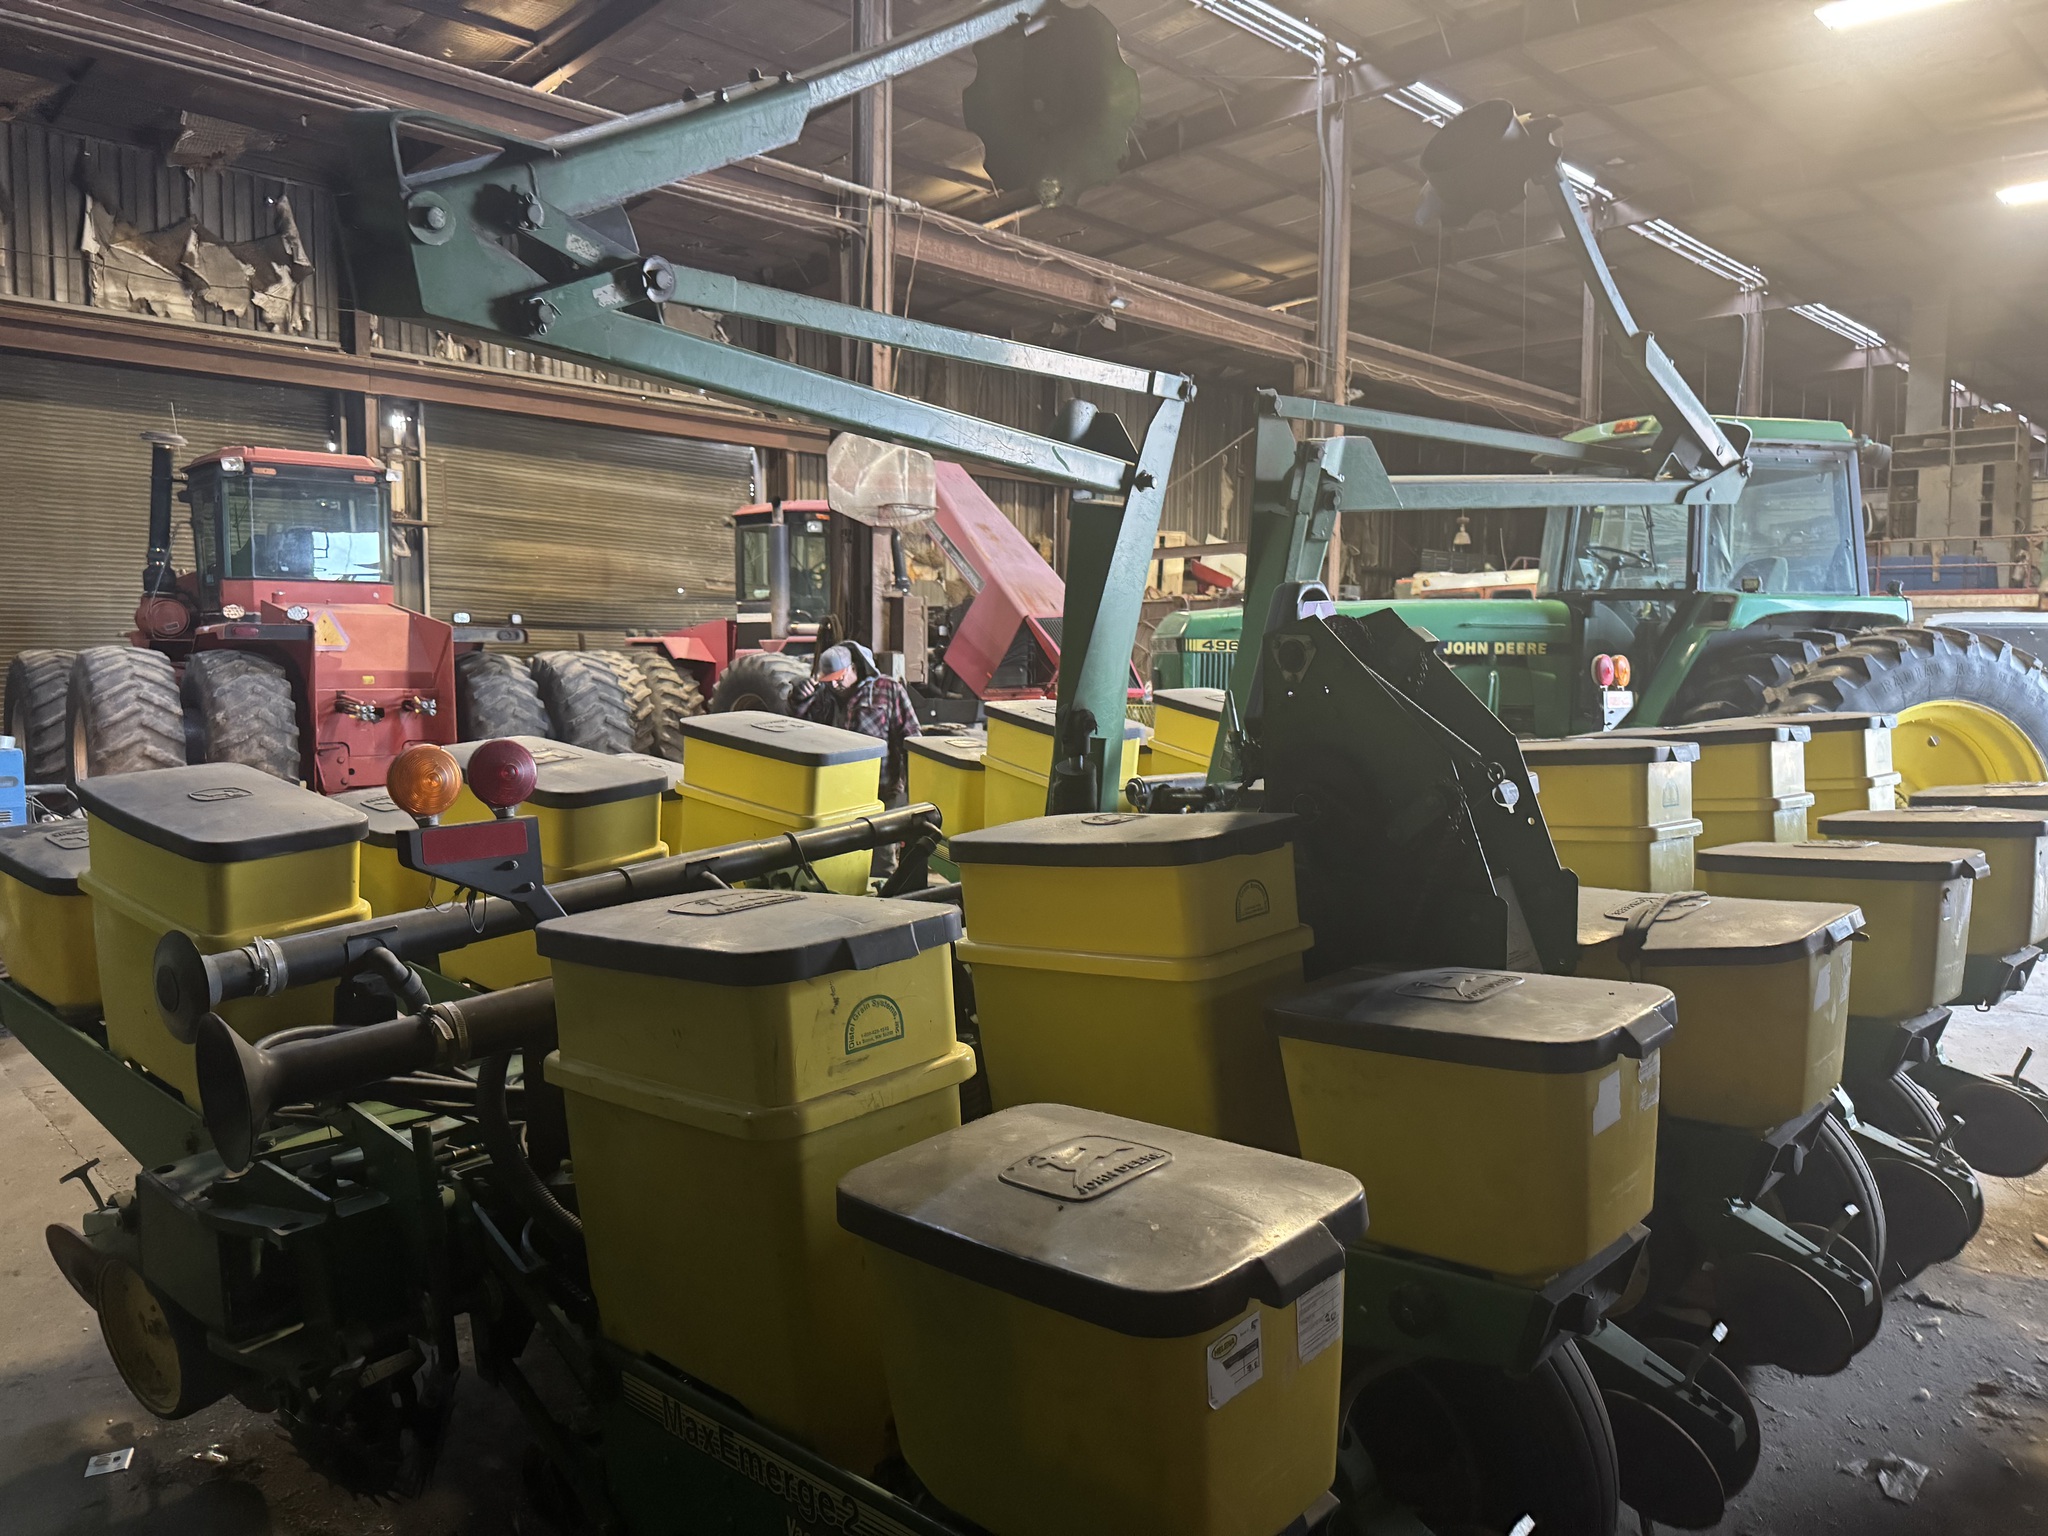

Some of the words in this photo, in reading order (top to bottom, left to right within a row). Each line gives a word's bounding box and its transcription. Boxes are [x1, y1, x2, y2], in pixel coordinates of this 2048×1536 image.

[1443, 641, 1489, 655] JOHN
[1494, 642, 1547, 656] DEERE
[852, 1002, 871, 1021] Grain
[1077, 1170, 1118, 1195] JOHN
[1114, 1152, 1166, 1174] DEERE
